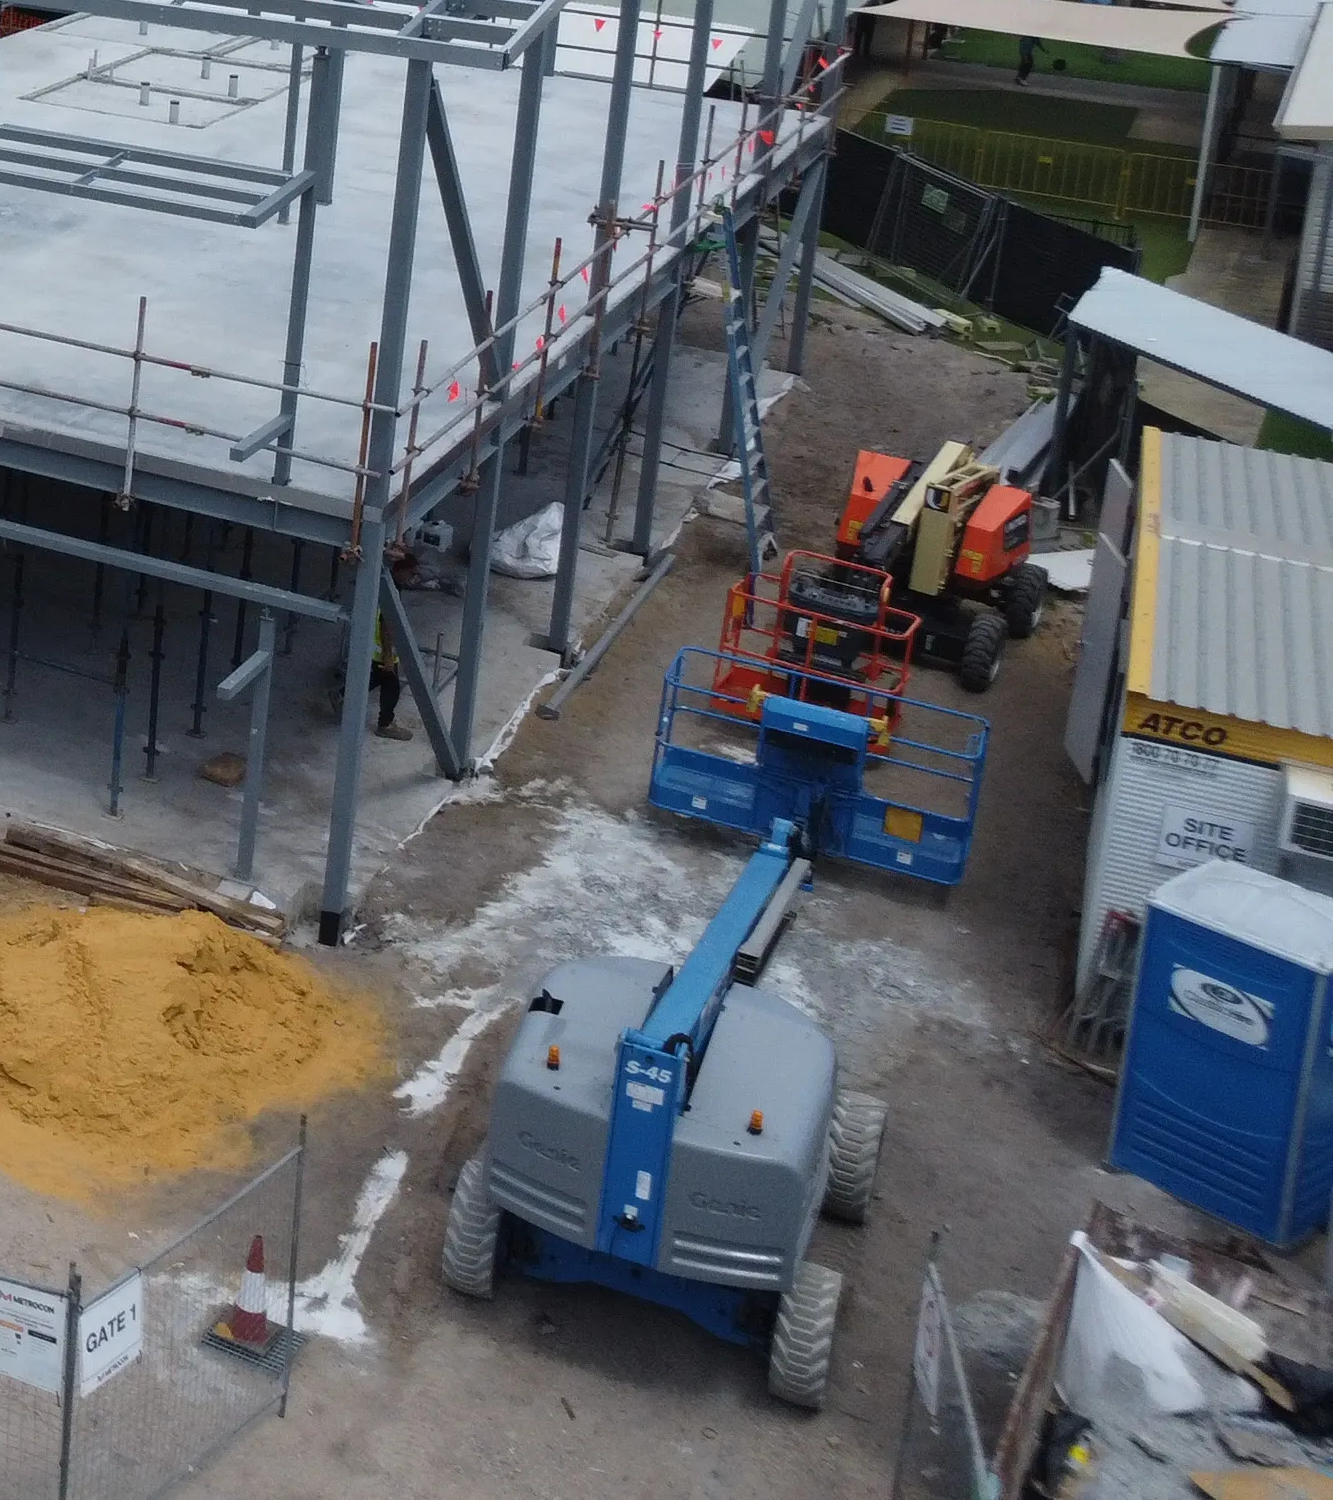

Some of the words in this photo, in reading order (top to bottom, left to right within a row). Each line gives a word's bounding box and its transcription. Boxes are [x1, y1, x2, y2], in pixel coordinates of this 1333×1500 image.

[1137, 713, 1228, 746] ATCO
[1183, 817, 1236, 842] SITE
[1164, 832, 1247, 863] OFFICE
[624, 1059, 673, 1084] S-45
[13, 1295, 55, 1314] METROCON
[85, 1310, 126, 1353] GATE
[129, 1303, 136, 1321] 1
